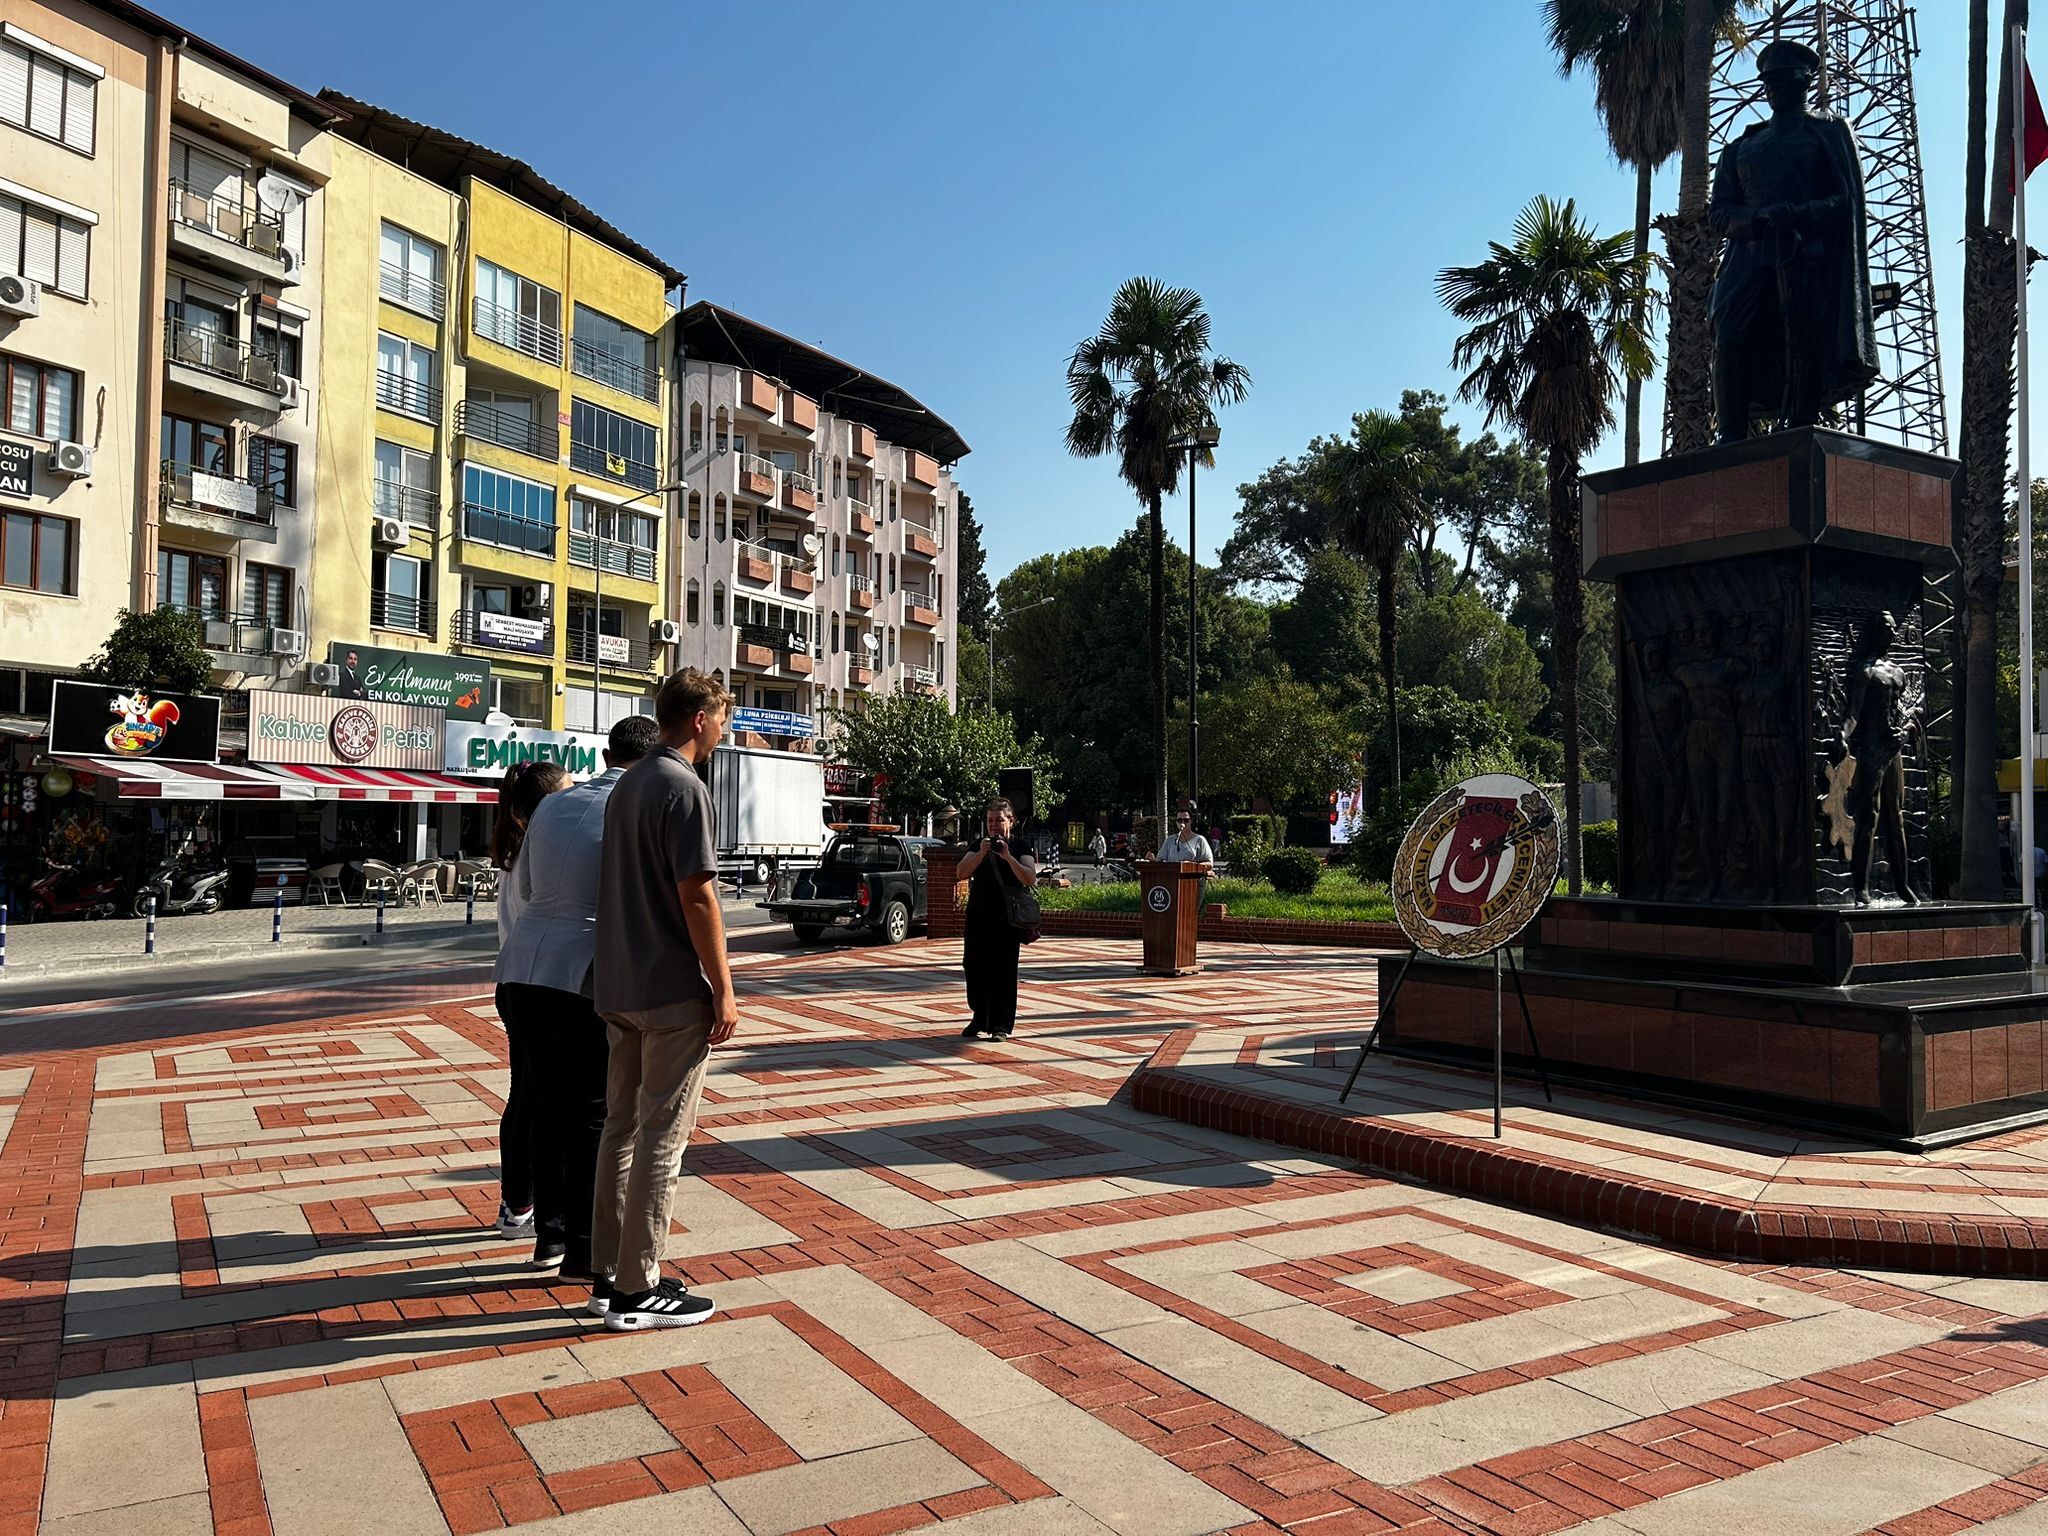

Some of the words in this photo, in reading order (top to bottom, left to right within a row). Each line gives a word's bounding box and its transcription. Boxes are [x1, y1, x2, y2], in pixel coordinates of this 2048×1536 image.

[0, 445, 29, 459] OSU
[600, 637, 628, 650] AVUKAT
[364, 664, 386, 686] Ev
[388, 666, 453, 692] Almanın
[367, 689, 383, 700] EN
[385, 691, 421, 704] KOLAY
[421, 694, 449, 706] YOLU
[258, 713, 328, 743] Kahve
[466, 730, 597, 775] EMİNEVİM
